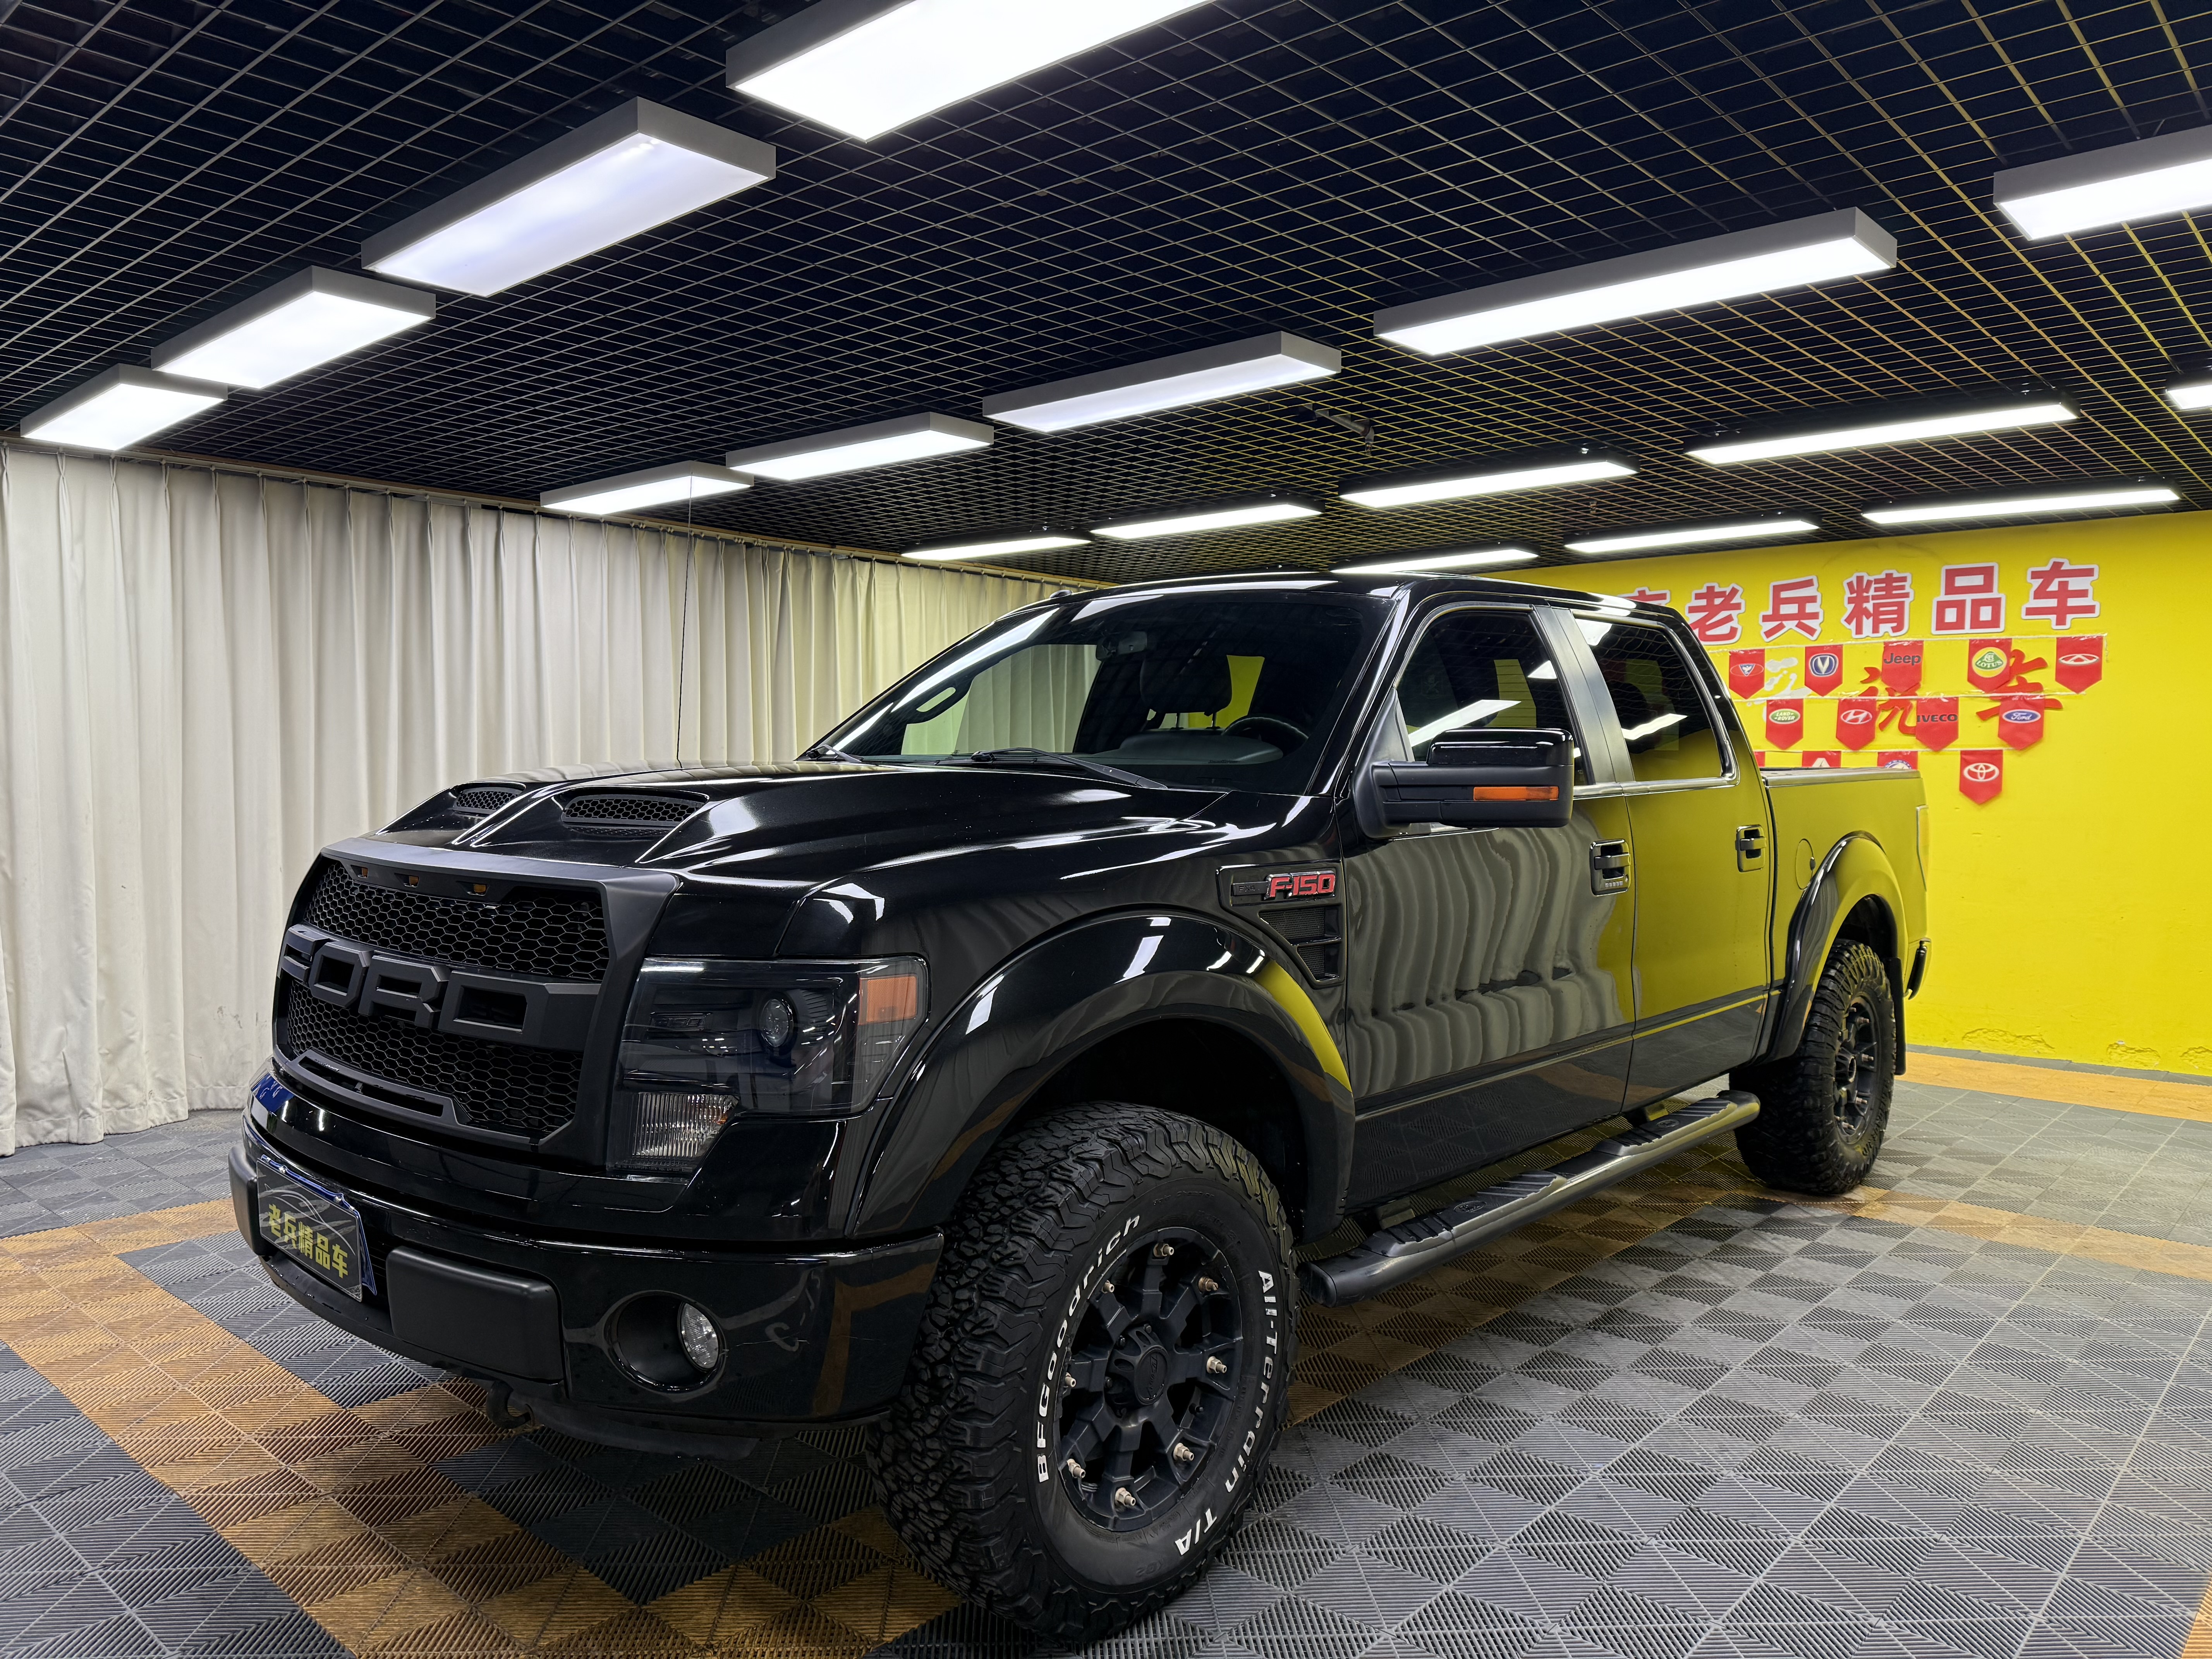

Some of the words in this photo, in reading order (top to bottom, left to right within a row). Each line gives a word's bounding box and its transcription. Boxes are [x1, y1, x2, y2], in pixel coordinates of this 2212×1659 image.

[1884, 653, 1921, 666] Jeep
[1976, 659, 2003, 668] LOTUS
[1917, 714, 1958, 722] IVECO
[1266, 871, 1336, 900] F-150
[278, 924, 544, 1047] FORD
[268, 1204, 348, 1278] 老兵精品车
[1036, 1214, 1141, 1483] BFGoodrich
[1225, 1270, 1279, 1493] All-Terrain
[1174, 1508, 1217, 1556] T/A
